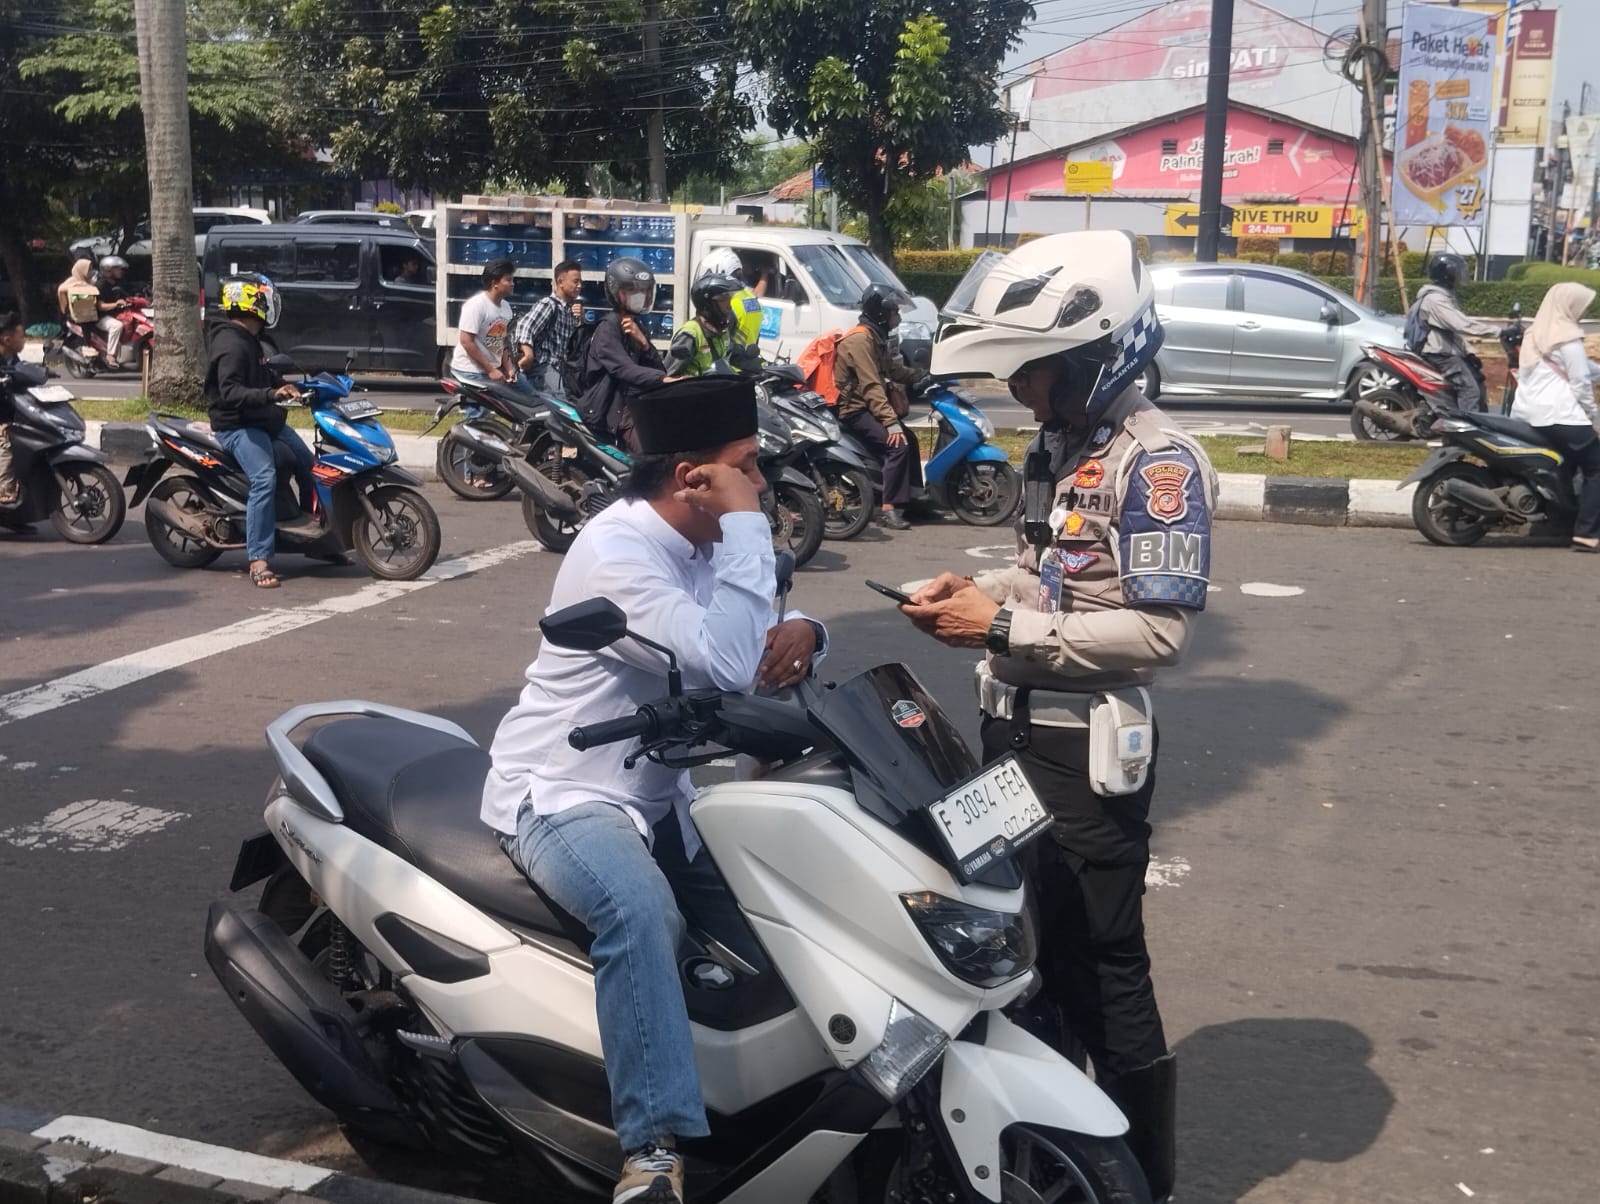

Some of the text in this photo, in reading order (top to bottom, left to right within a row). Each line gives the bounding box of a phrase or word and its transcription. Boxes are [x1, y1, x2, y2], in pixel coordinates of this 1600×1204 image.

[1411, 31, 1449, 54] Paket
[1233, 210, 1318, 223] RIVE THRU
[1247, 225, 1285, 233] 24 Jam
[1101, 357, 1138, 391] KORLANTAS
[1149, 466, 1184, 476] POLRES
[1129, 531, 1201, 573] BM
[939, 766, 1027, 837] F 3094 FEA
[970, 851, 992, 872] YAMAHA
